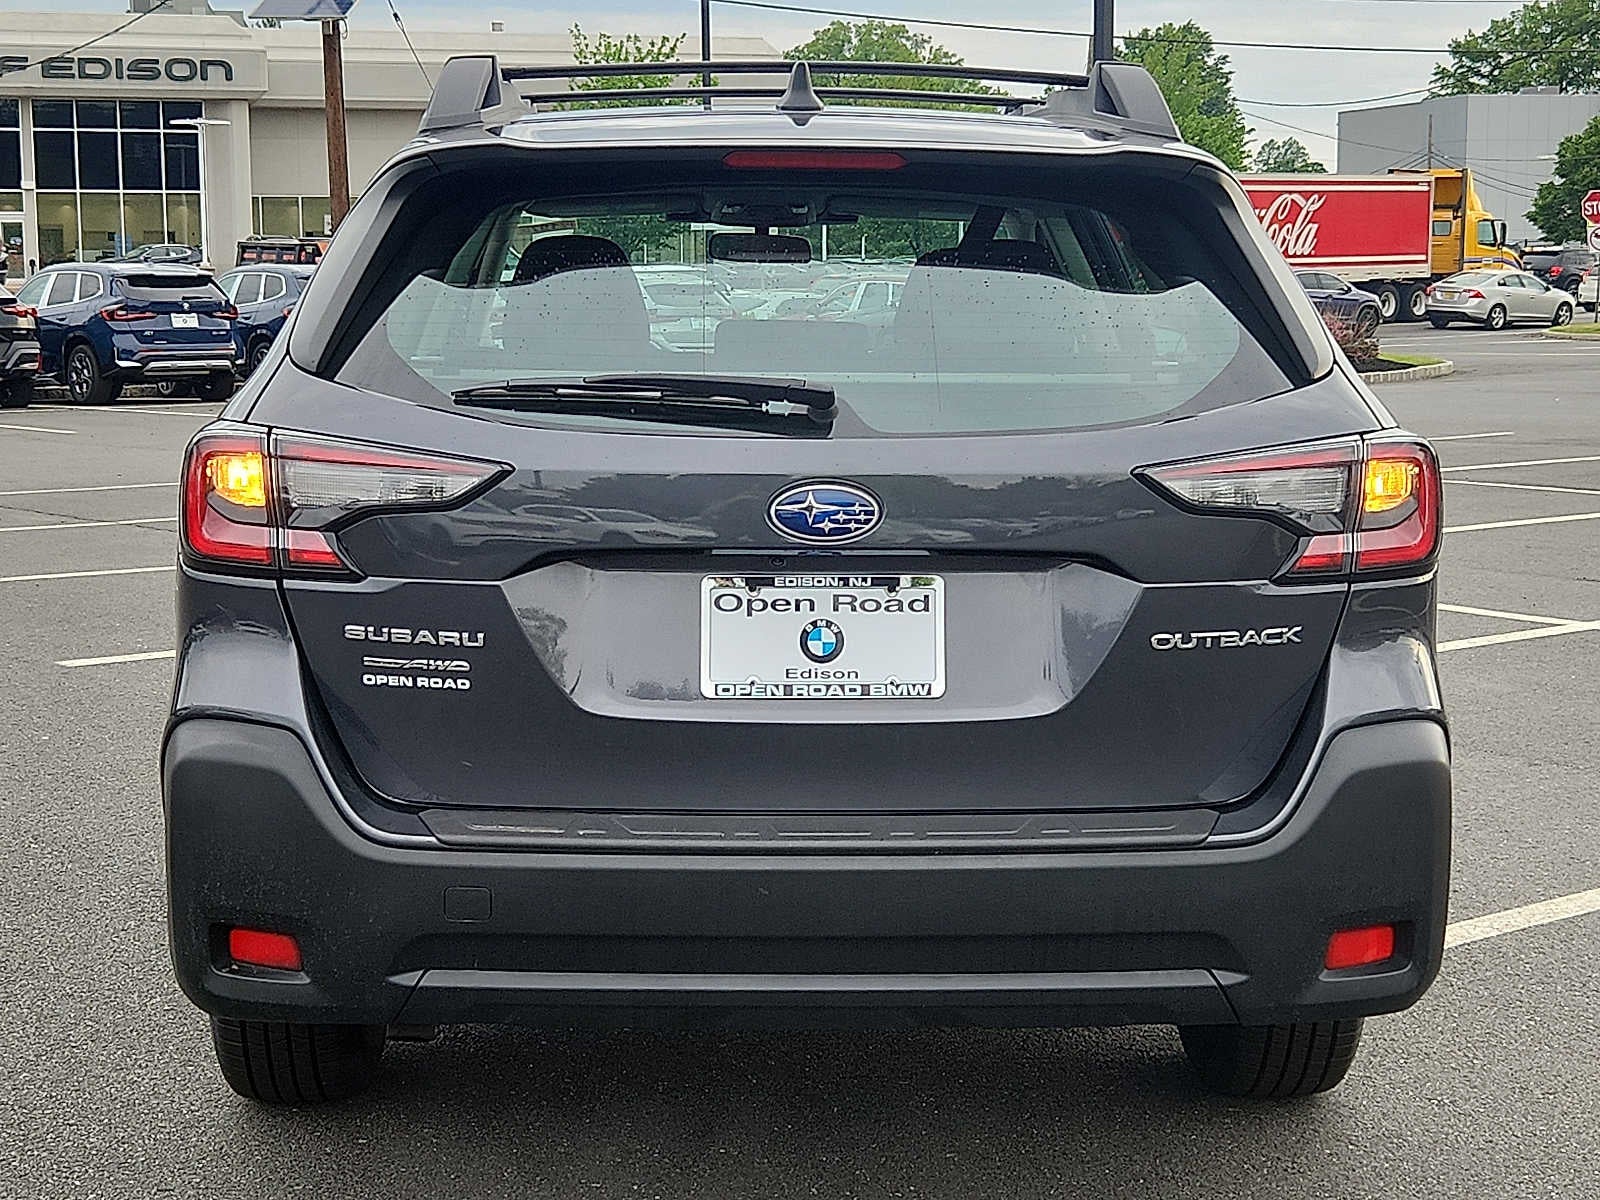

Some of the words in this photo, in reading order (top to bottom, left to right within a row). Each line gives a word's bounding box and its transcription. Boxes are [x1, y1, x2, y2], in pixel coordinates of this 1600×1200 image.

[774, 577, 844, 587] EDISON,
[848, 577, 872, 587] NJ
[713, 594, 815, 617] Open
[832, 594, 930, 613] Road
[344, 624, 485, 647] SUBARU
[1151, 626, 1303, 650] OUTBACK
[402, 659, 471, 671] AWD
[785, 668, 859, 679] Edison
[362, 674, 413, 687] OPEN
[416, 676, 471, 690] ROAD
[716, 684, 784, 696] OPEN
[792, 684, 862, 696] ROAD
[869, 684, 930, 696] BMW
